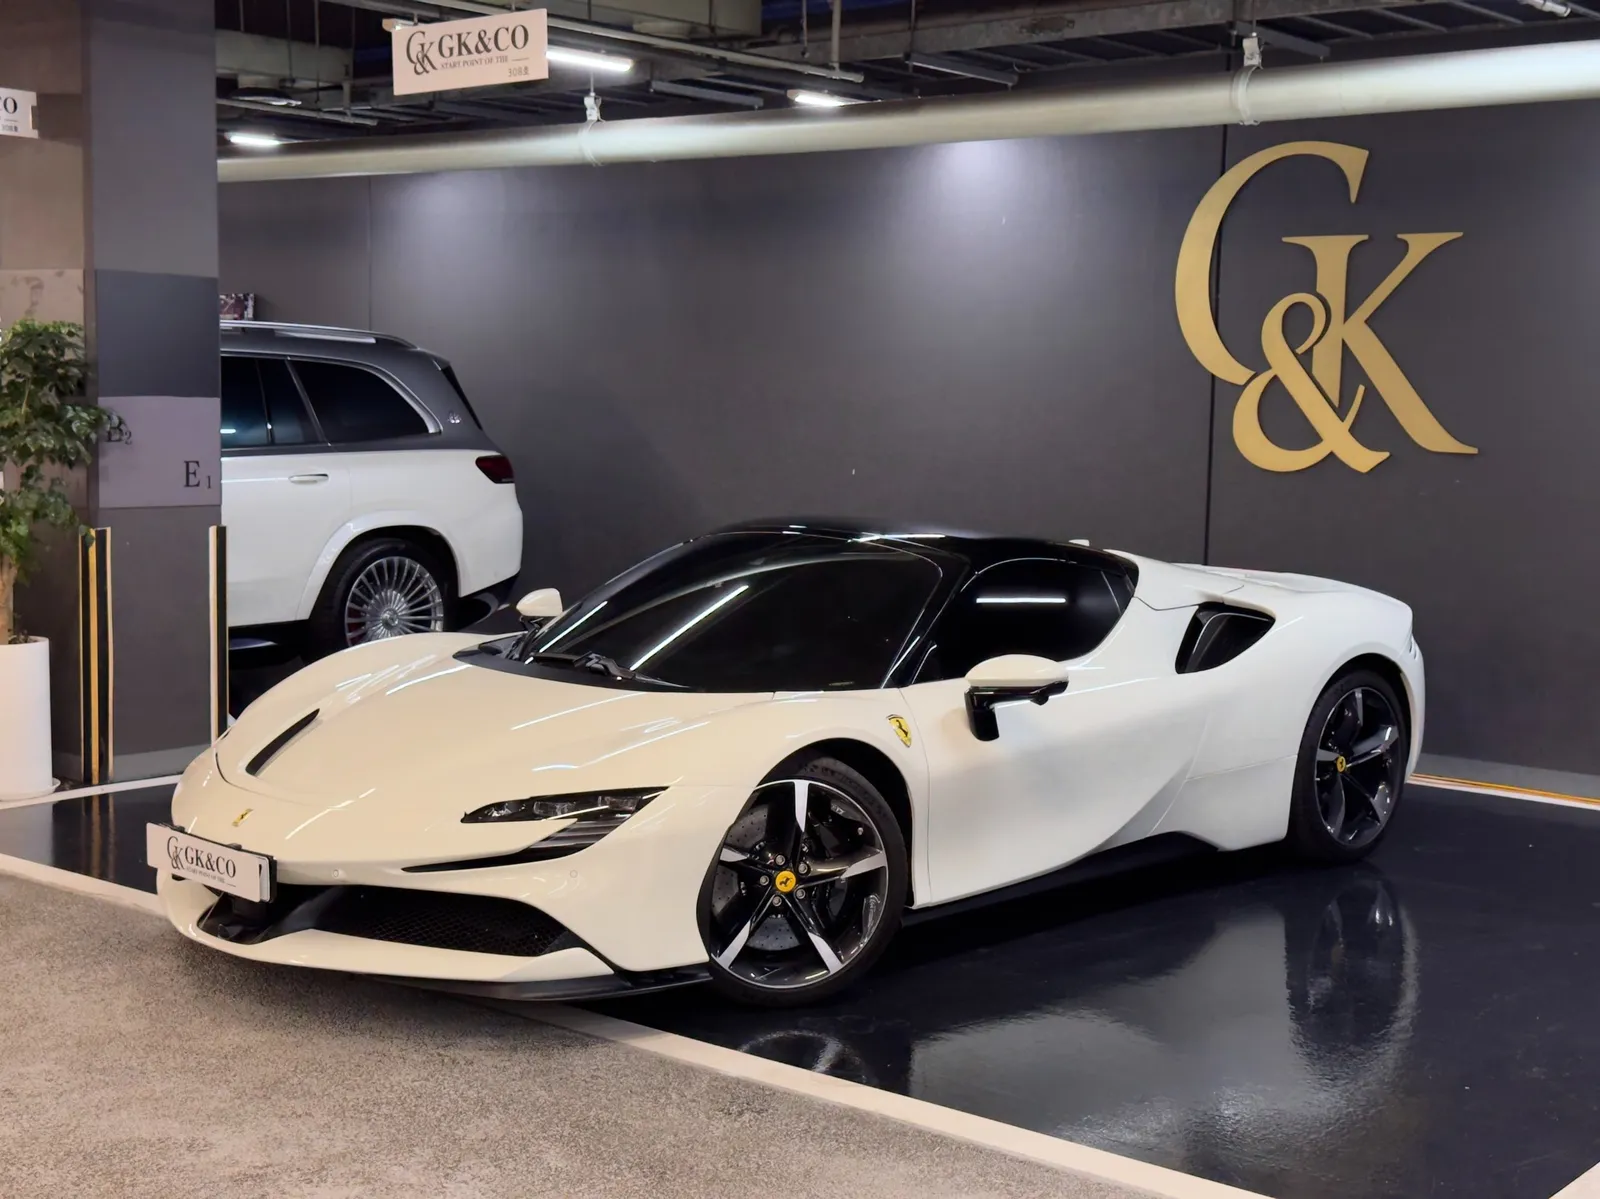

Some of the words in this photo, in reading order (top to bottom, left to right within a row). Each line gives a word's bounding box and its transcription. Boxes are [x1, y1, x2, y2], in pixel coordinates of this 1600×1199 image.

[438, 24, 529, 58] GK&CO
[440, 60, 461, 70] START
[0, 96, 18, 114] O
[185, 846, 236, 878] GK&CO
